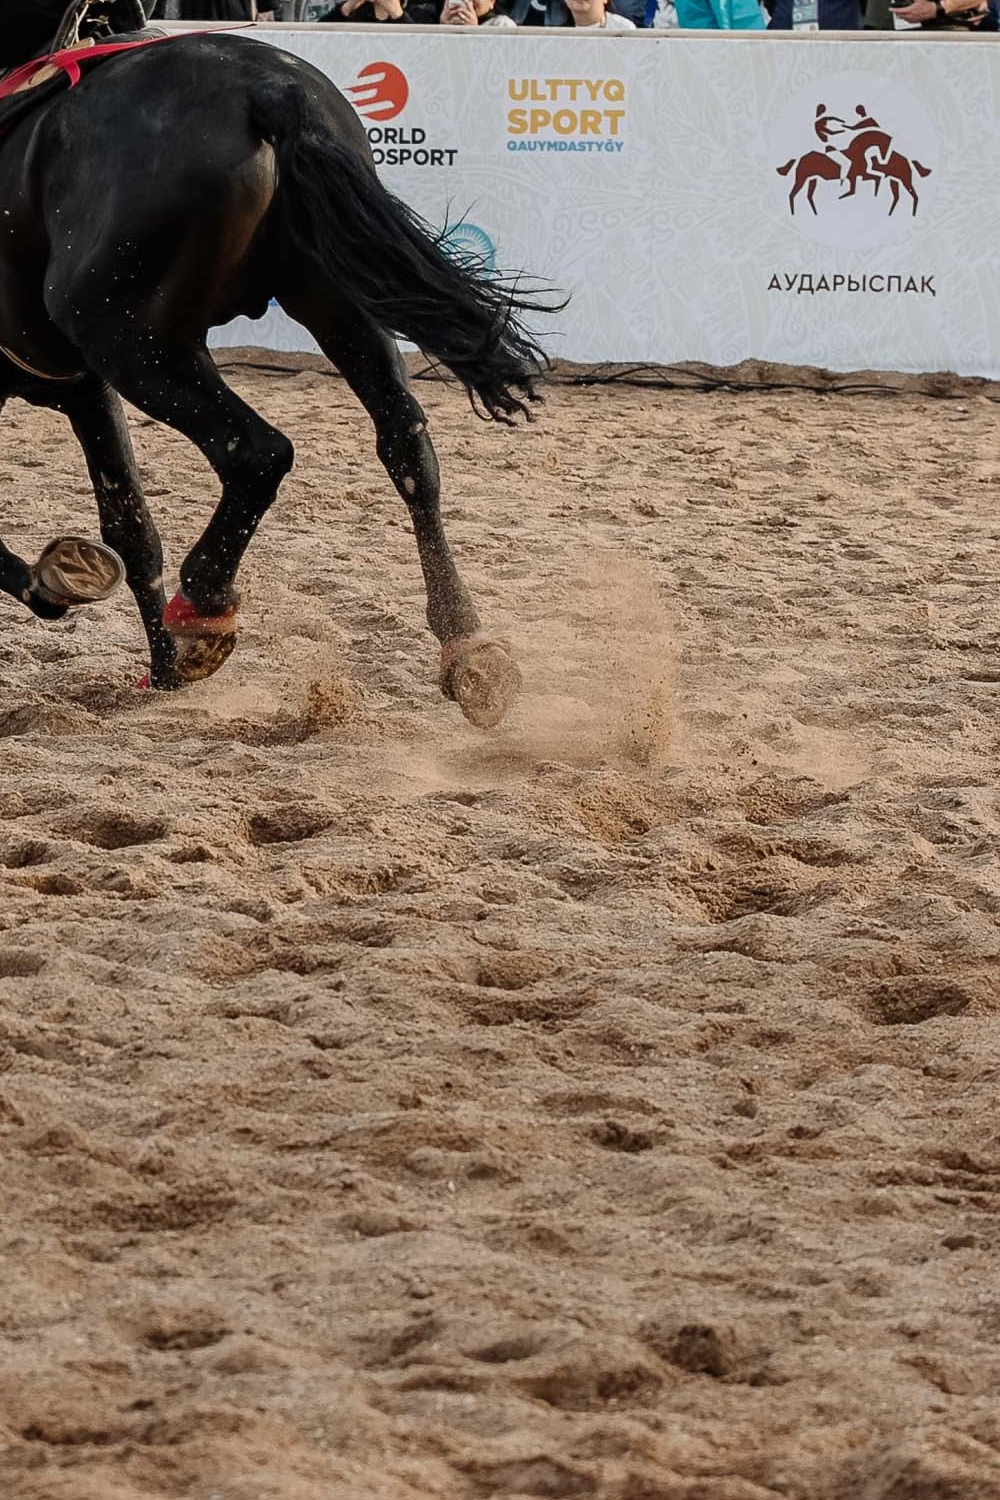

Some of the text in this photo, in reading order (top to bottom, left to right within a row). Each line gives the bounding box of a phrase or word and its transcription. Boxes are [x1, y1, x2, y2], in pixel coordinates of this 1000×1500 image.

[508, 79, 625, 102] ULTTYQ
[507, 108, 625, 135] SPORT
[366, 127, 426, 145] ORLD
[768, 273, 936, 296] АУДАРЫСПАҚ
